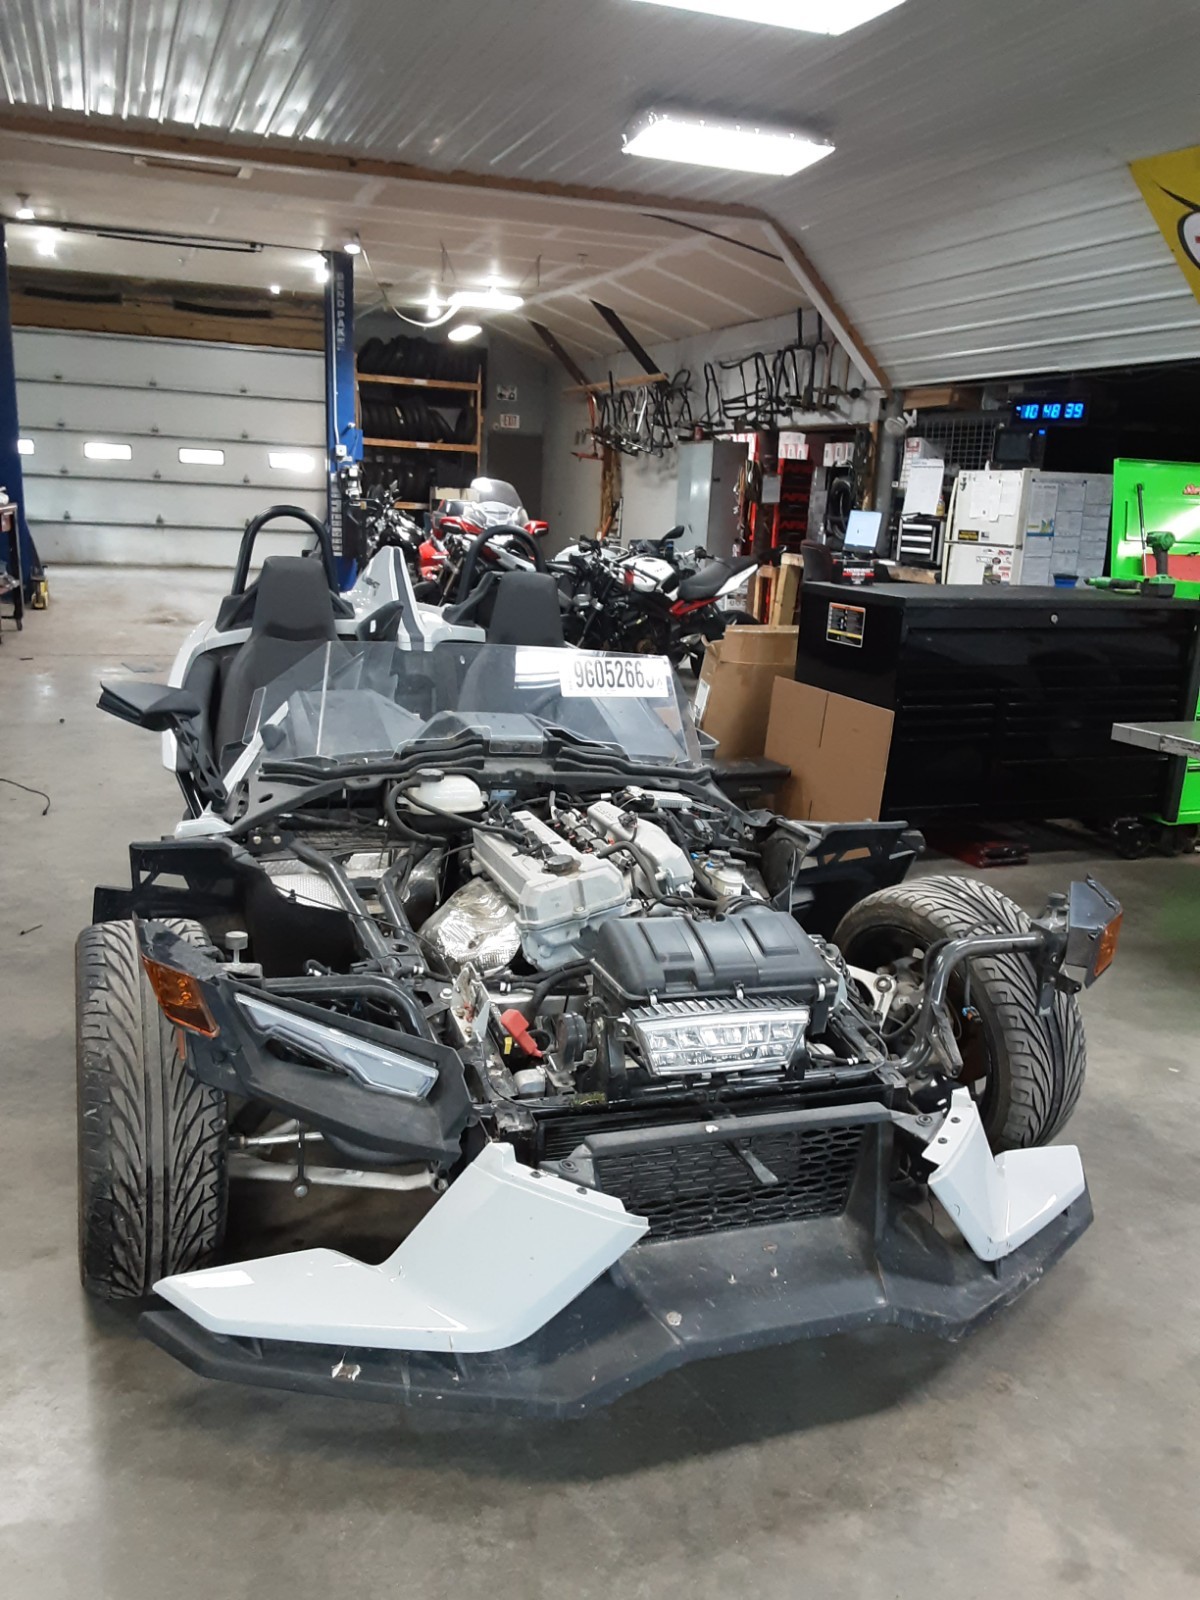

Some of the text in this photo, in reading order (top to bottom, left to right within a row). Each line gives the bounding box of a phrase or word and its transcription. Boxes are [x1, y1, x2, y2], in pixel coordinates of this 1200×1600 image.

[1023, 403, 1084, 419] 10 48 39
